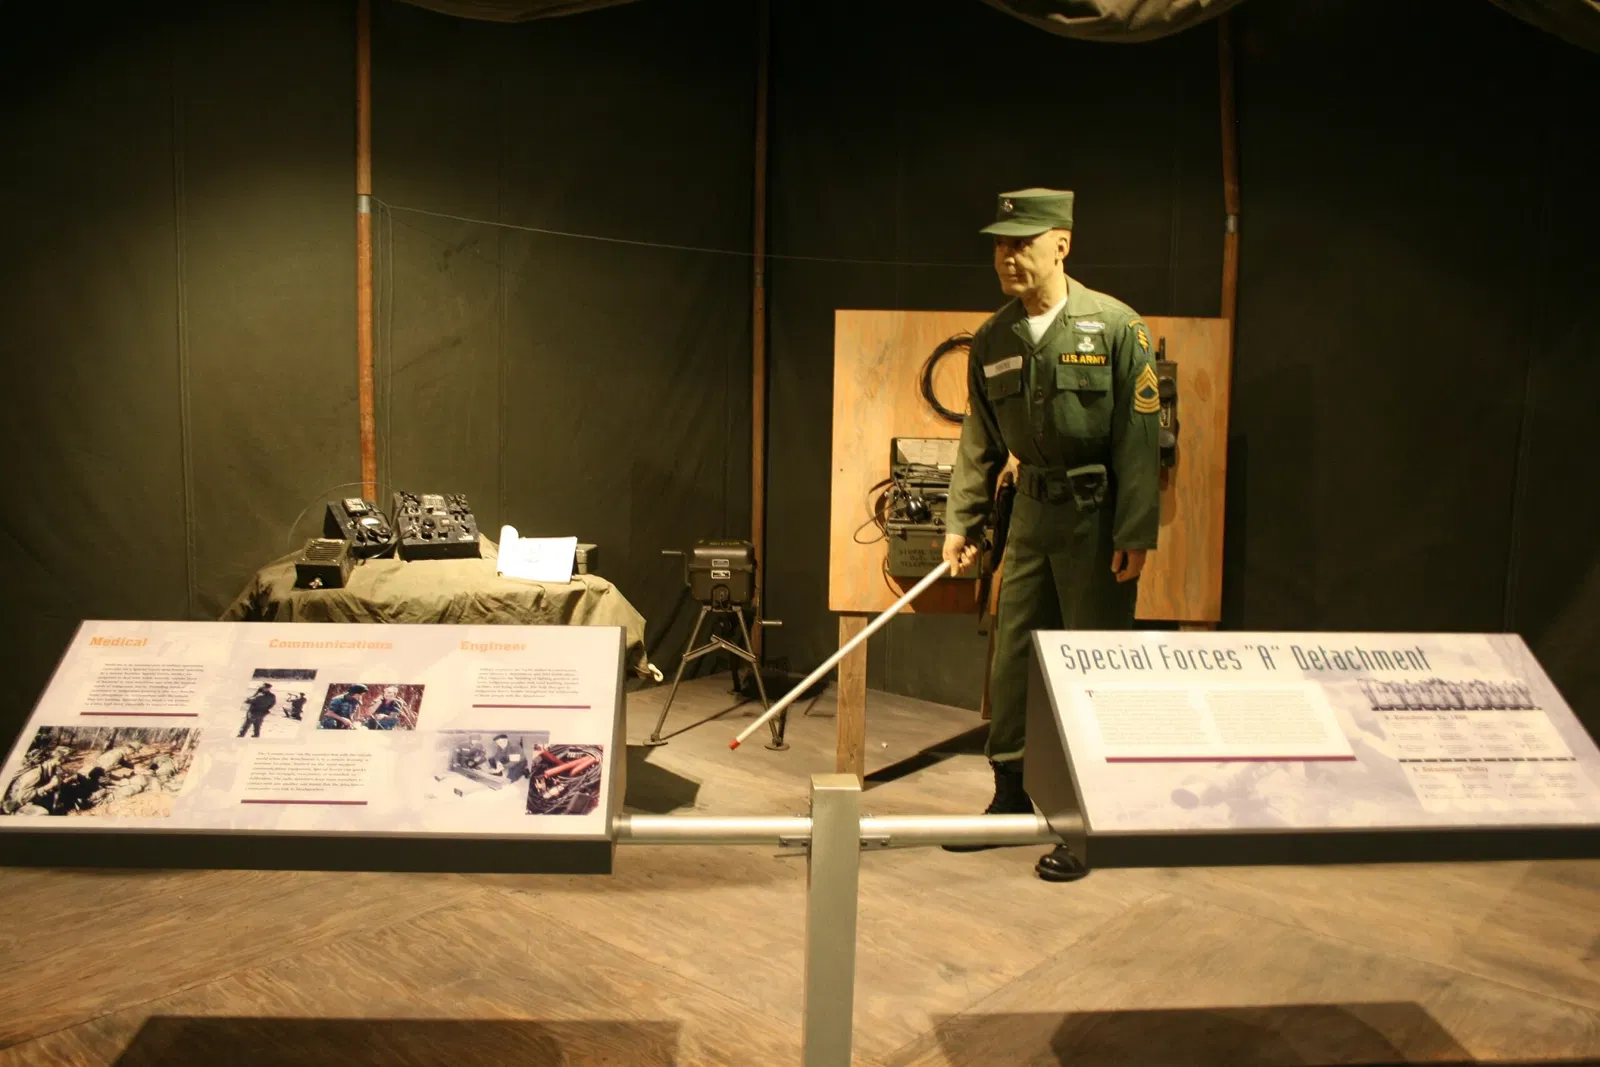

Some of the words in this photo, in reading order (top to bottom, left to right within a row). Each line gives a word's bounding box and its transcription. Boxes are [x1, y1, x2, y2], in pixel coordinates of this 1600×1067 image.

[89, 636, 149, 647] Medical
[268, 639, 393, 650] Communications
[460, 640, 527, 652] Engineer
[1060, 644, 1153, 675] Special
[1159, 644, 1243, 671] Forces
[1291, 645, 1432, 671] Detachment
